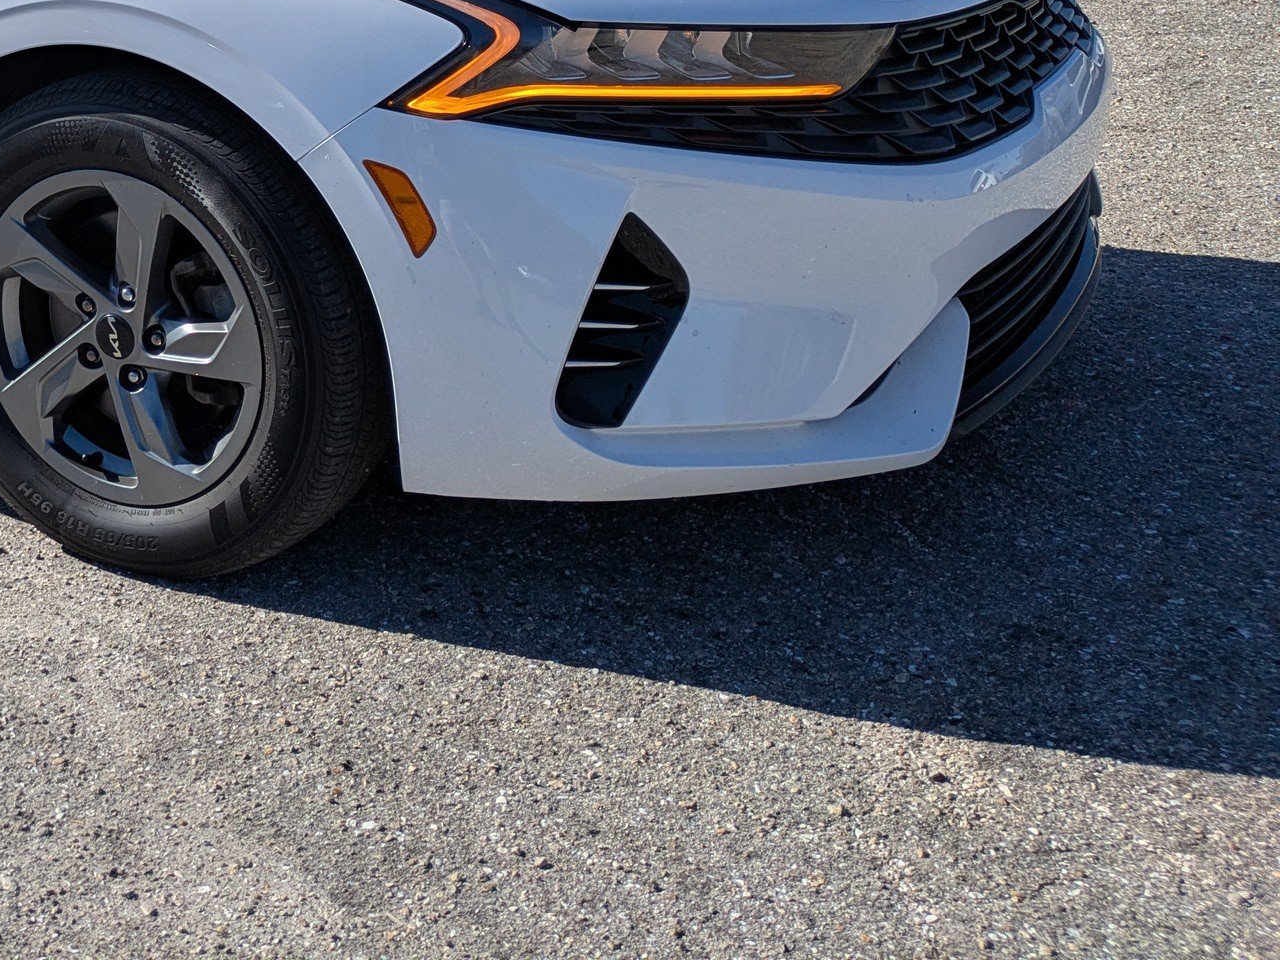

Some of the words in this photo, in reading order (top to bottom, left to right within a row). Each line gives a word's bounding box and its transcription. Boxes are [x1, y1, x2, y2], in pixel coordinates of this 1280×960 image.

[17, 480, 53, 515] 95H
[55, 512, 90, 537] R16
[93, 525, 160, 551] 205/65
